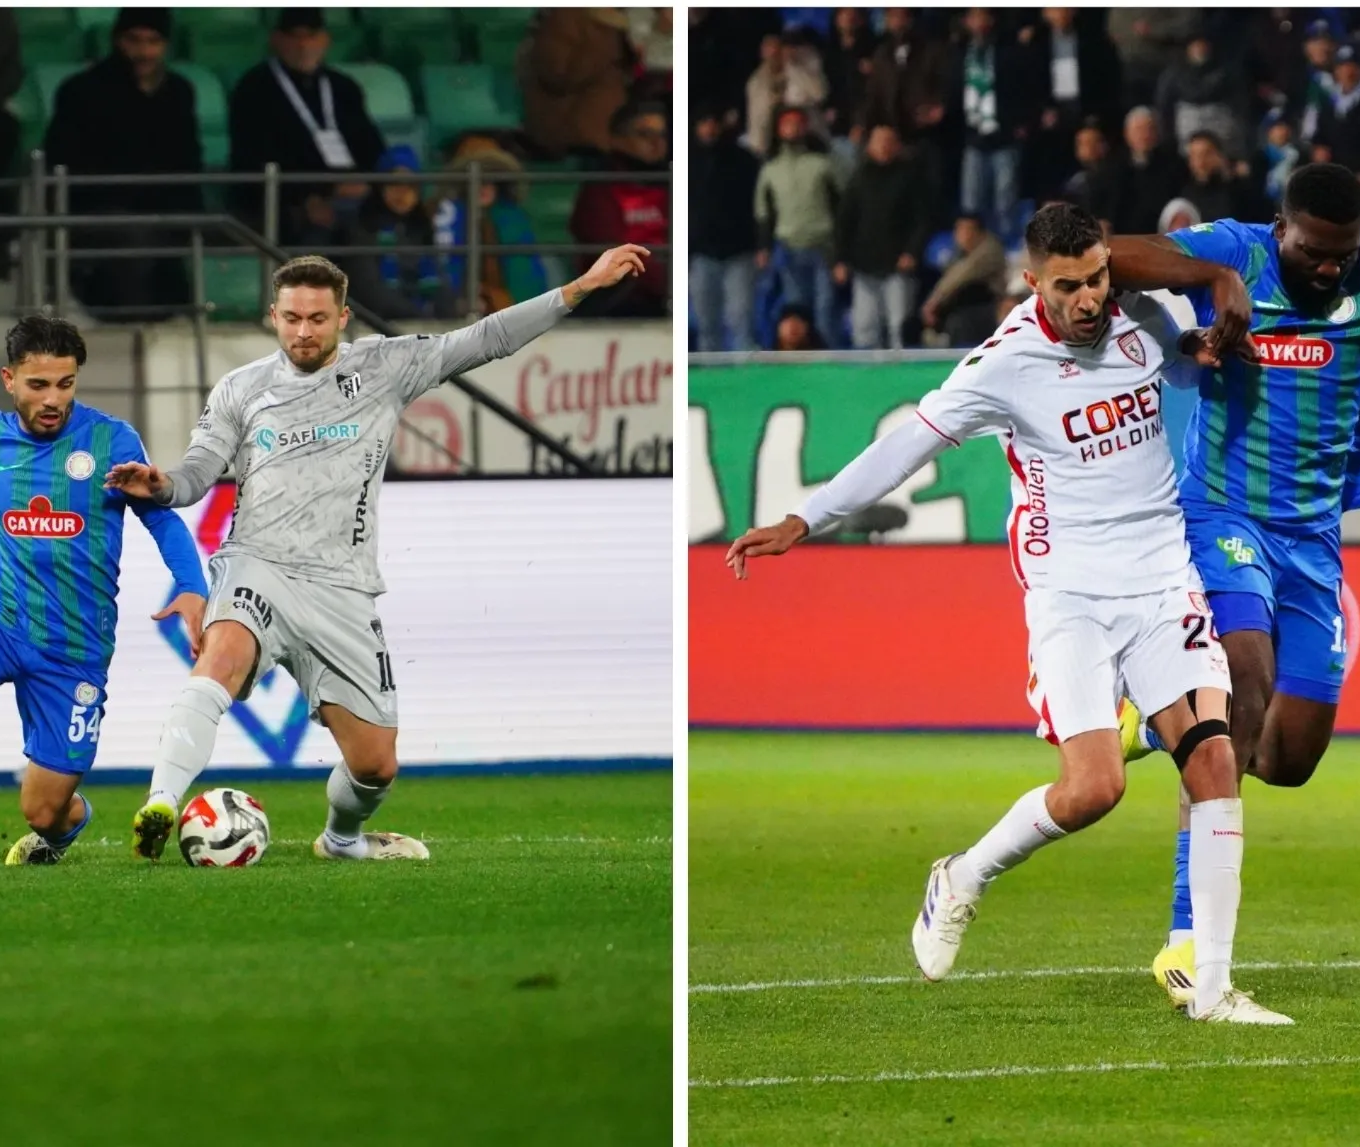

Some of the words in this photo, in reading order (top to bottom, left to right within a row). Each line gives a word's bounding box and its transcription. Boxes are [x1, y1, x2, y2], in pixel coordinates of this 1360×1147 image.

[278, 423, 361, 448] SAFİPORT
[6, 515, 77, 533] ÇAYKUR
[233, 586, 274, 630] nuh
[67, 704, 101, 744] 54
